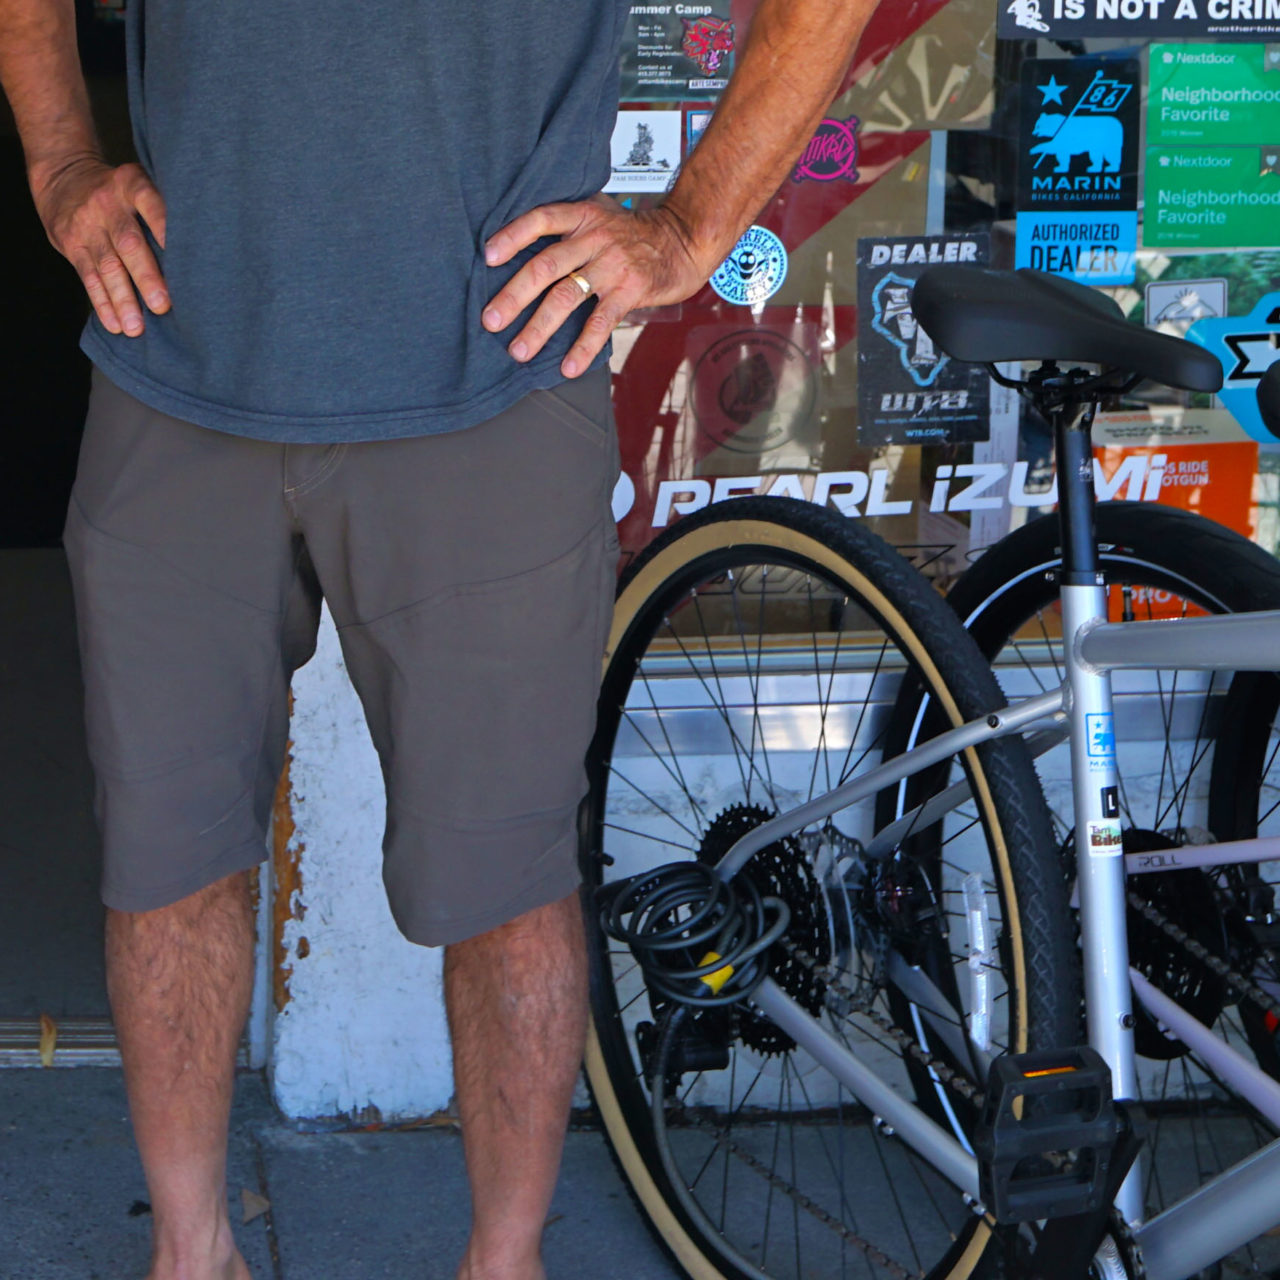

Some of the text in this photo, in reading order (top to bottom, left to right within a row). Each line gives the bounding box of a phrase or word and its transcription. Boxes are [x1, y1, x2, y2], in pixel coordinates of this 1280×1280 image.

[675, 3, 713, 17] Camp
[1177, 51, 1236, 64] Nextdoor
[1089, 85, 1119, 106] 86
[1161, 106, 1230, 121] Favorite
[1173, 155, 1233, 167] Nextdoor
[1031, 175, 1121, 191] MARIN
[1031, 192, 1120, 201] BIKES CALIFORNIA
[1157, 209, 1227, 225] Favorite
[1031, 223, 1120, 241] AUTHORIZED
[870, 242, 978, 266] DEALER
[1030, 245, 1118, 272] DEALER
[880, 390, 970, 412] WTB
[1178, 460, 1209, 473] RIDE
[1108, 793, 1116, 811] L
[1138, 854, 1182, 868] ROLL
